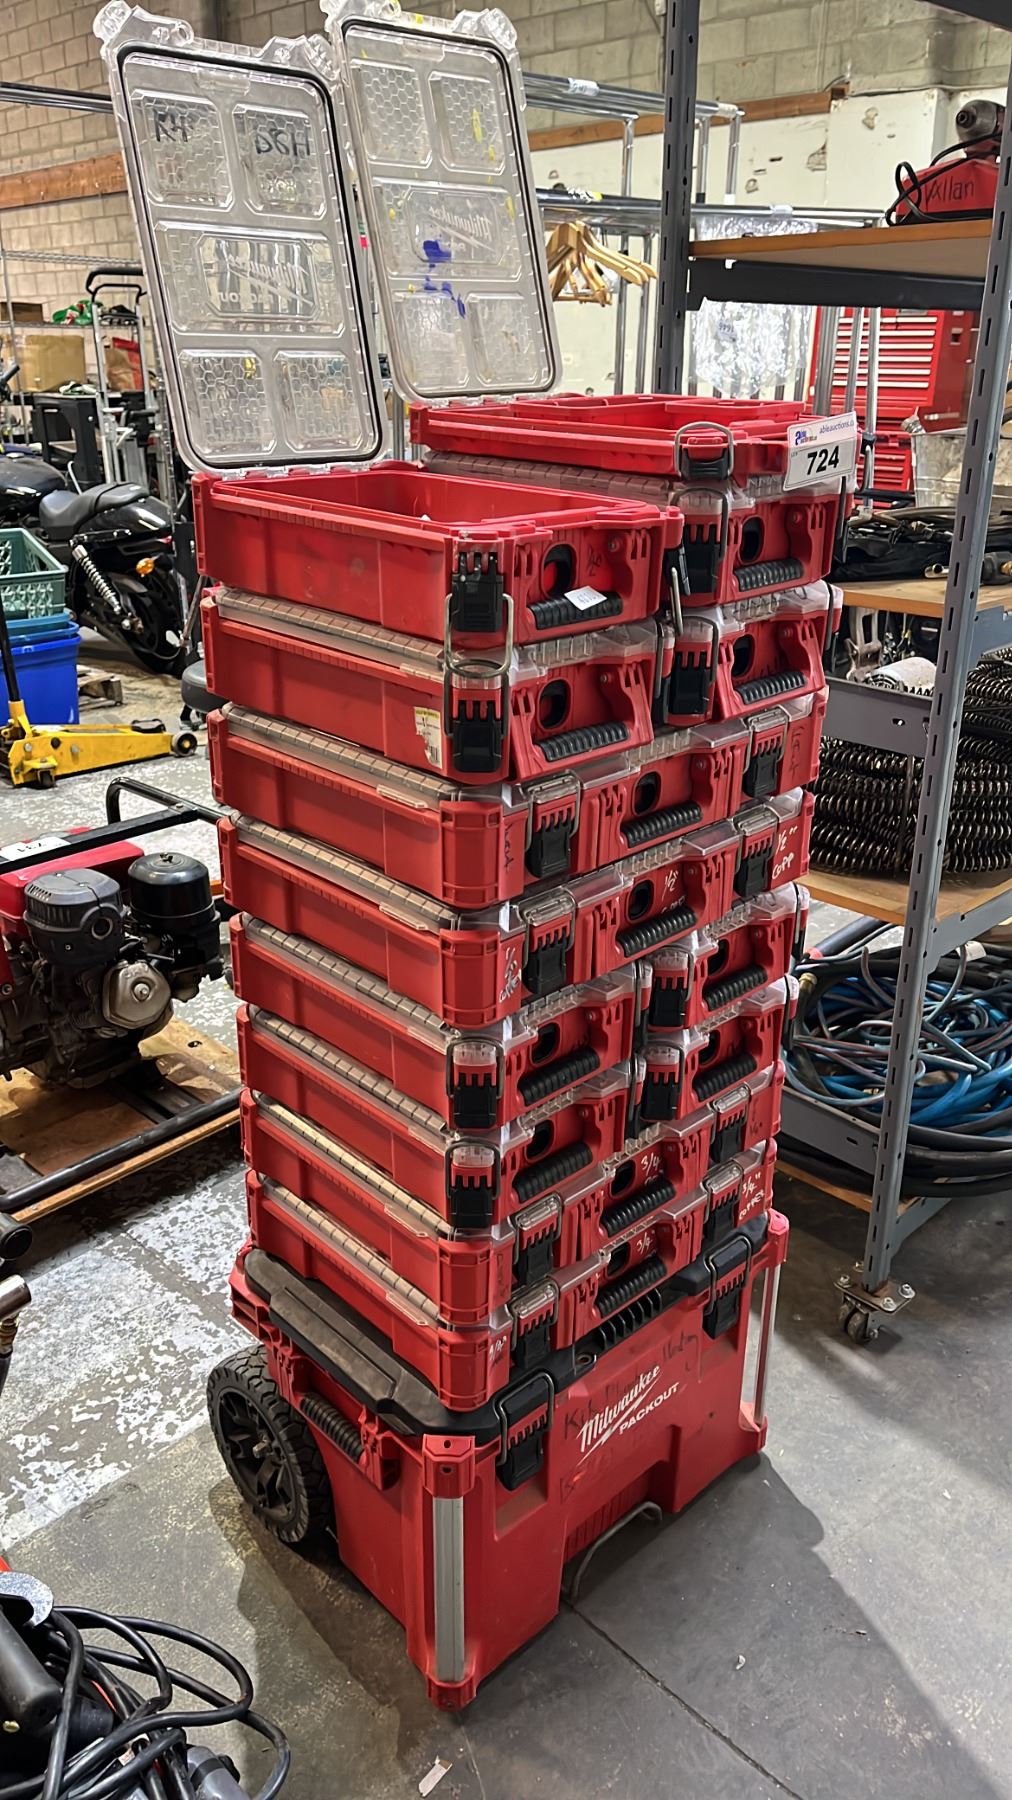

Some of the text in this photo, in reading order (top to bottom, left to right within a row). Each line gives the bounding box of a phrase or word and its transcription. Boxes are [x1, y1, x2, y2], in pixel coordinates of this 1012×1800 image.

[806, 445, 840, 476] 724
[576, 1365, 661, 1453] Milwaukee
[619, 1381, 680, 1435] PACKOUT
